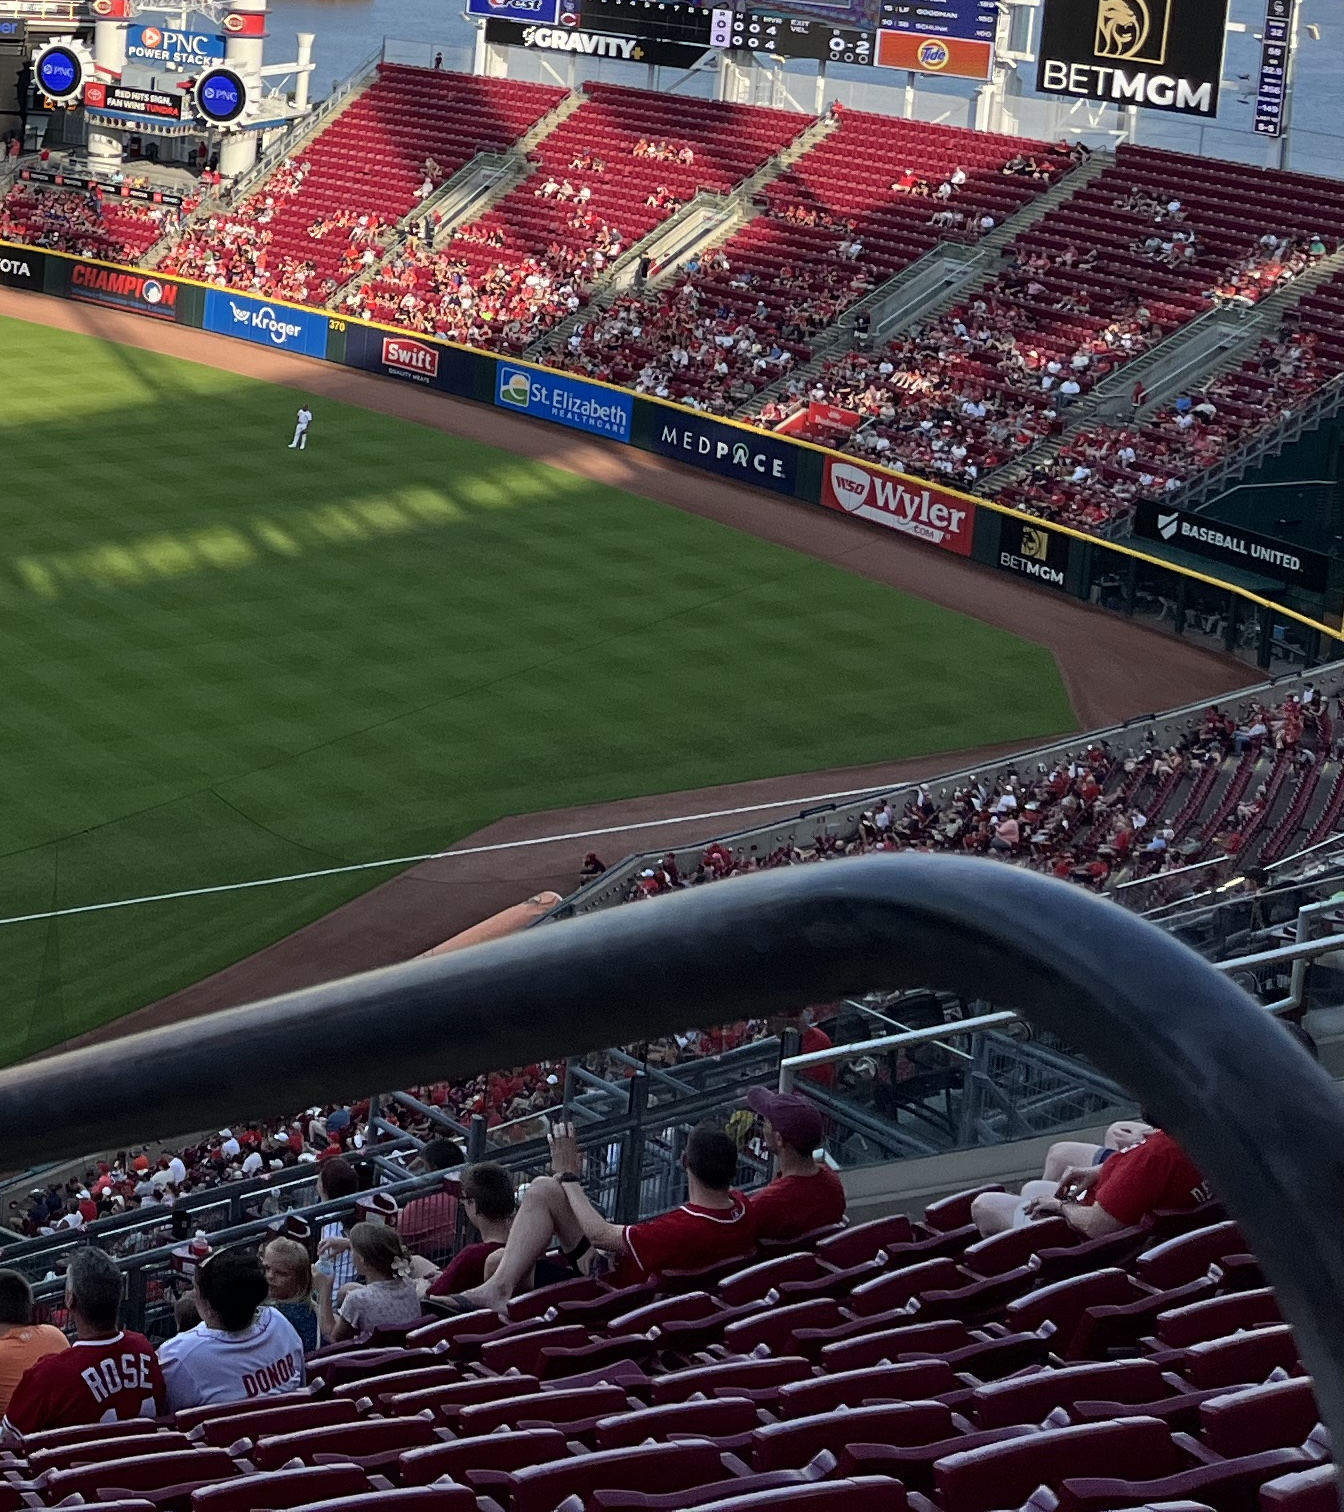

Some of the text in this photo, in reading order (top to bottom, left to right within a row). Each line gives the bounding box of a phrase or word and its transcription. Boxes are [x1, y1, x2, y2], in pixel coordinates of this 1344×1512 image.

[790, 19, 810, 28] EXIT
[128, 45, 170, 61] POWER
[162, 31, 209, 55] PNC
[921, 45, 946, 61] Tide
[1043, 59, 1212, 113] BETMGM
[107, 98, 179, 116] FAN WINS TUNDRA
[251, 307, 302, 344] Kroger
[329, 319, 345, 333] 370
[387, 343, 433, 371] Swift
[531, 383, 627, 426] St. Elizabeth
[551, 407, 626, 435] HEALTHCARE
[662, 425, 783, 478] MEDPACE
[871, 476, 966, 533] Wyler
[1181, 521, 1248, 555] BASEBALL
[1000, 552, 1064, 585] BETMGM
[81, 1353, 153, 1404] ROSE
[241, 1352, 300, 1399] DONOR
